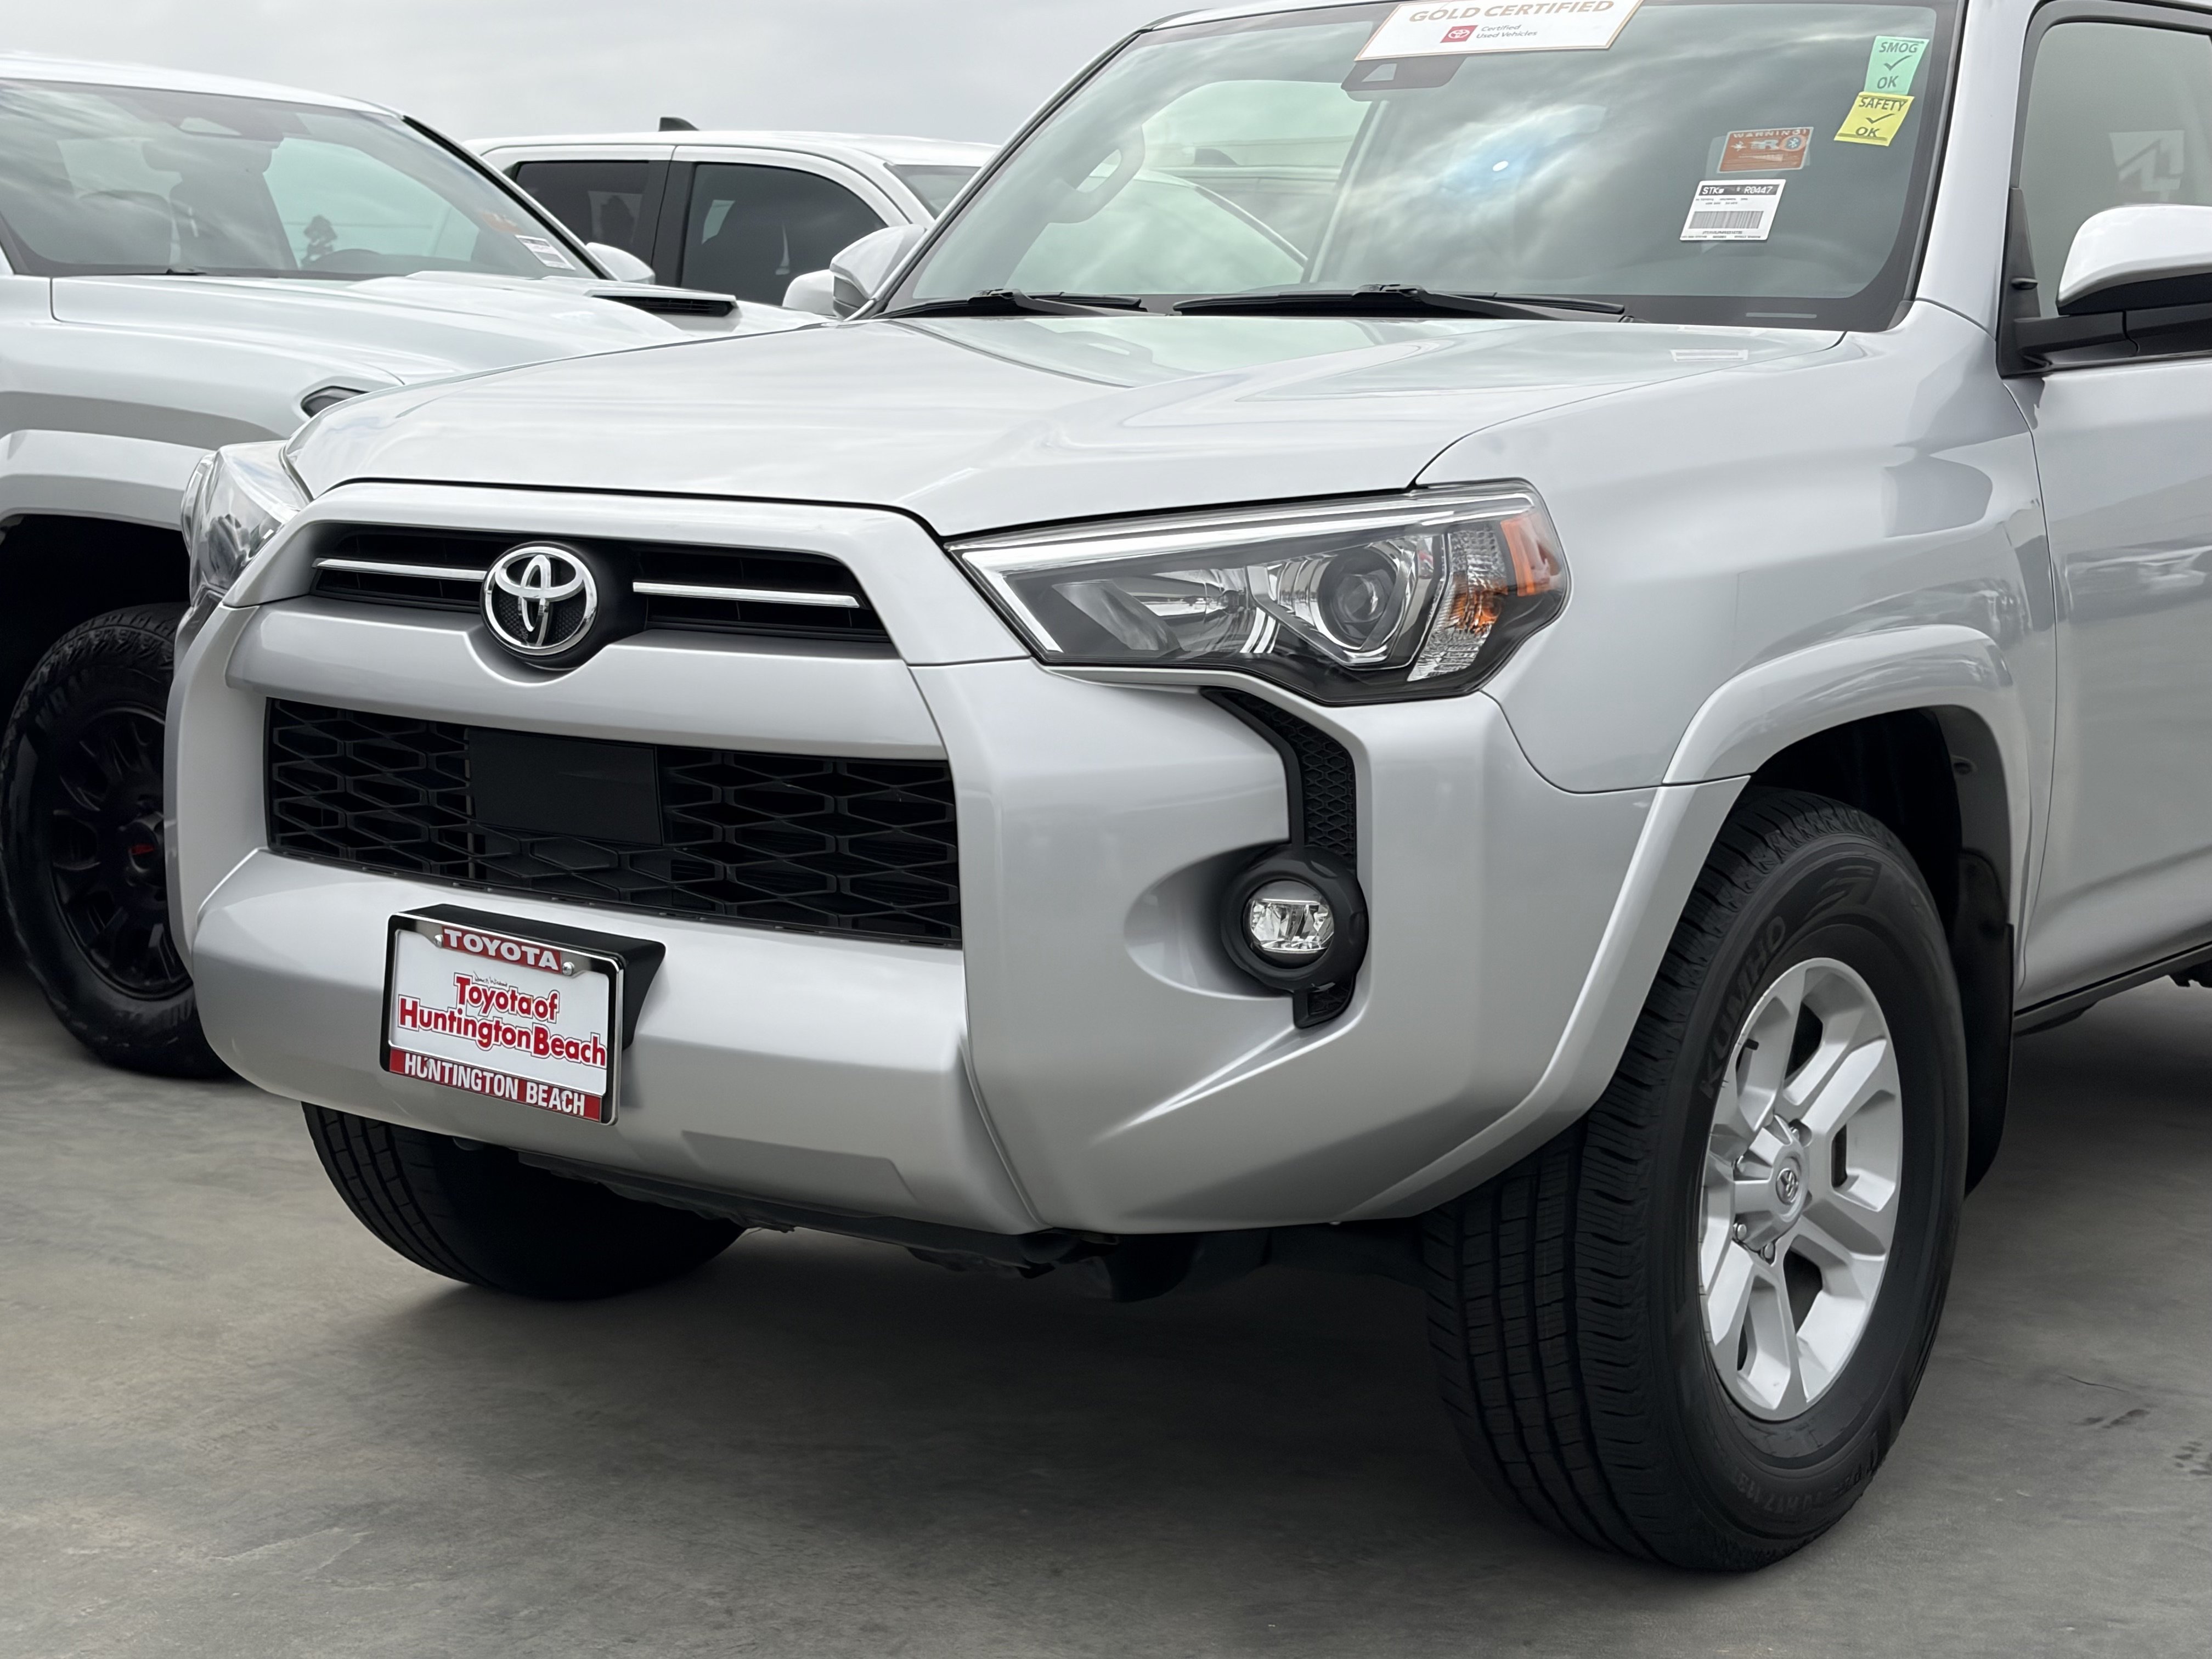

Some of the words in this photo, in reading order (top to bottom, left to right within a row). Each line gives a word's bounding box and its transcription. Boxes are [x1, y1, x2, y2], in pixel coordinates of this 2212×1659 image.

[1409, 7, 1481, 22] GOLD
[1484, 1, 1614, 17] CERTIFIED
[1879, 42, 1919, 53] SMOG
[1877, 76, 1899, 89] OK
[1859, 97, 1908, 111] SAFETY
[1855, 127, 1880, 137] OK
[444, 929, 559, 971] TOYOTA
[404, 1052, 518, 1101] HUNTINGTON
[526, 1081, 585, 1116] BEACH
